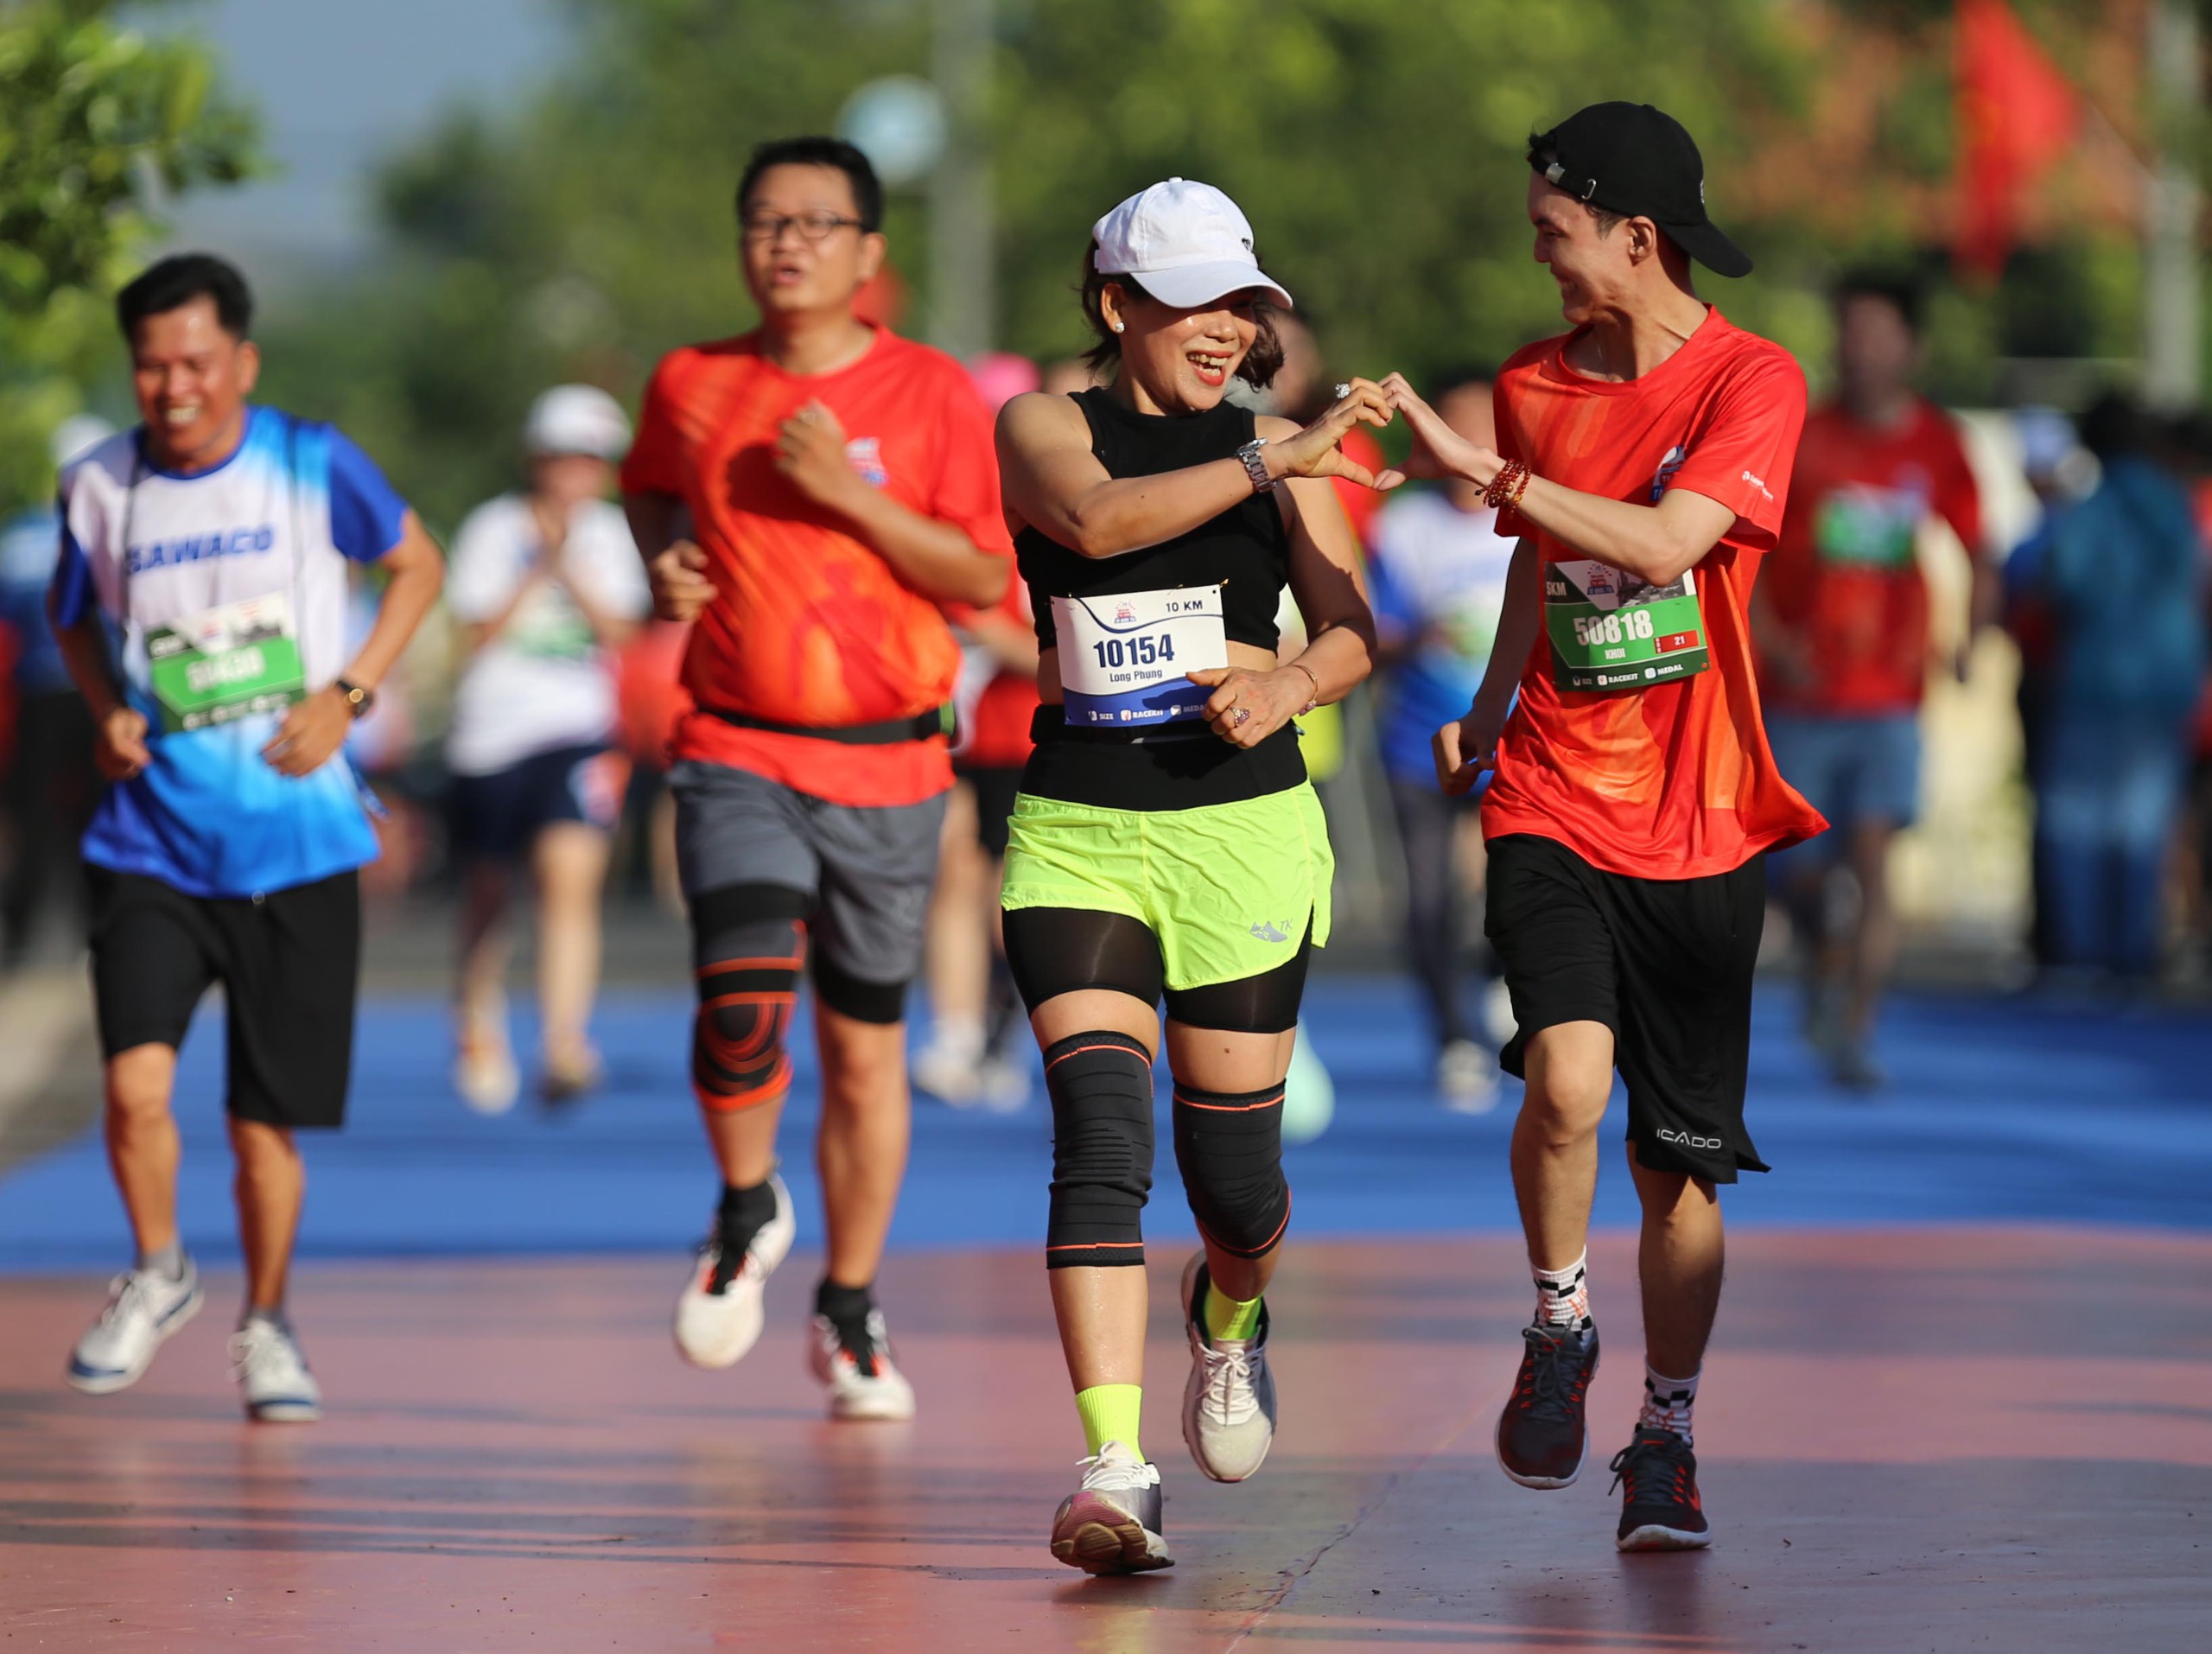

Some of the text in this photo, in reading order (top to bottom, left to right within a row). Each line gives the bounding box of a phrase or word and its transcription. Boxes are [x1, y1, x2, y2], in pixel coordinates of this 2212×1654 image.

[126, 525, 273, 572] SAWACO
[1166, 600, 1203, 613] 10 KM
[1573, 609, 1653, 646] 50818
[1674, 636, 1685, 646] 21
[1093, 634, 1174, 668] 10154
[1109, 670, 1163, 683] Long Phung
[1608, 673, 1638, 683] RACEKIT
[1657, 664, 1683, 675] MEDAL
[1183, 704, 1206, 713] MEDA
[1656, 1128, 1722, 1149] ICADO
